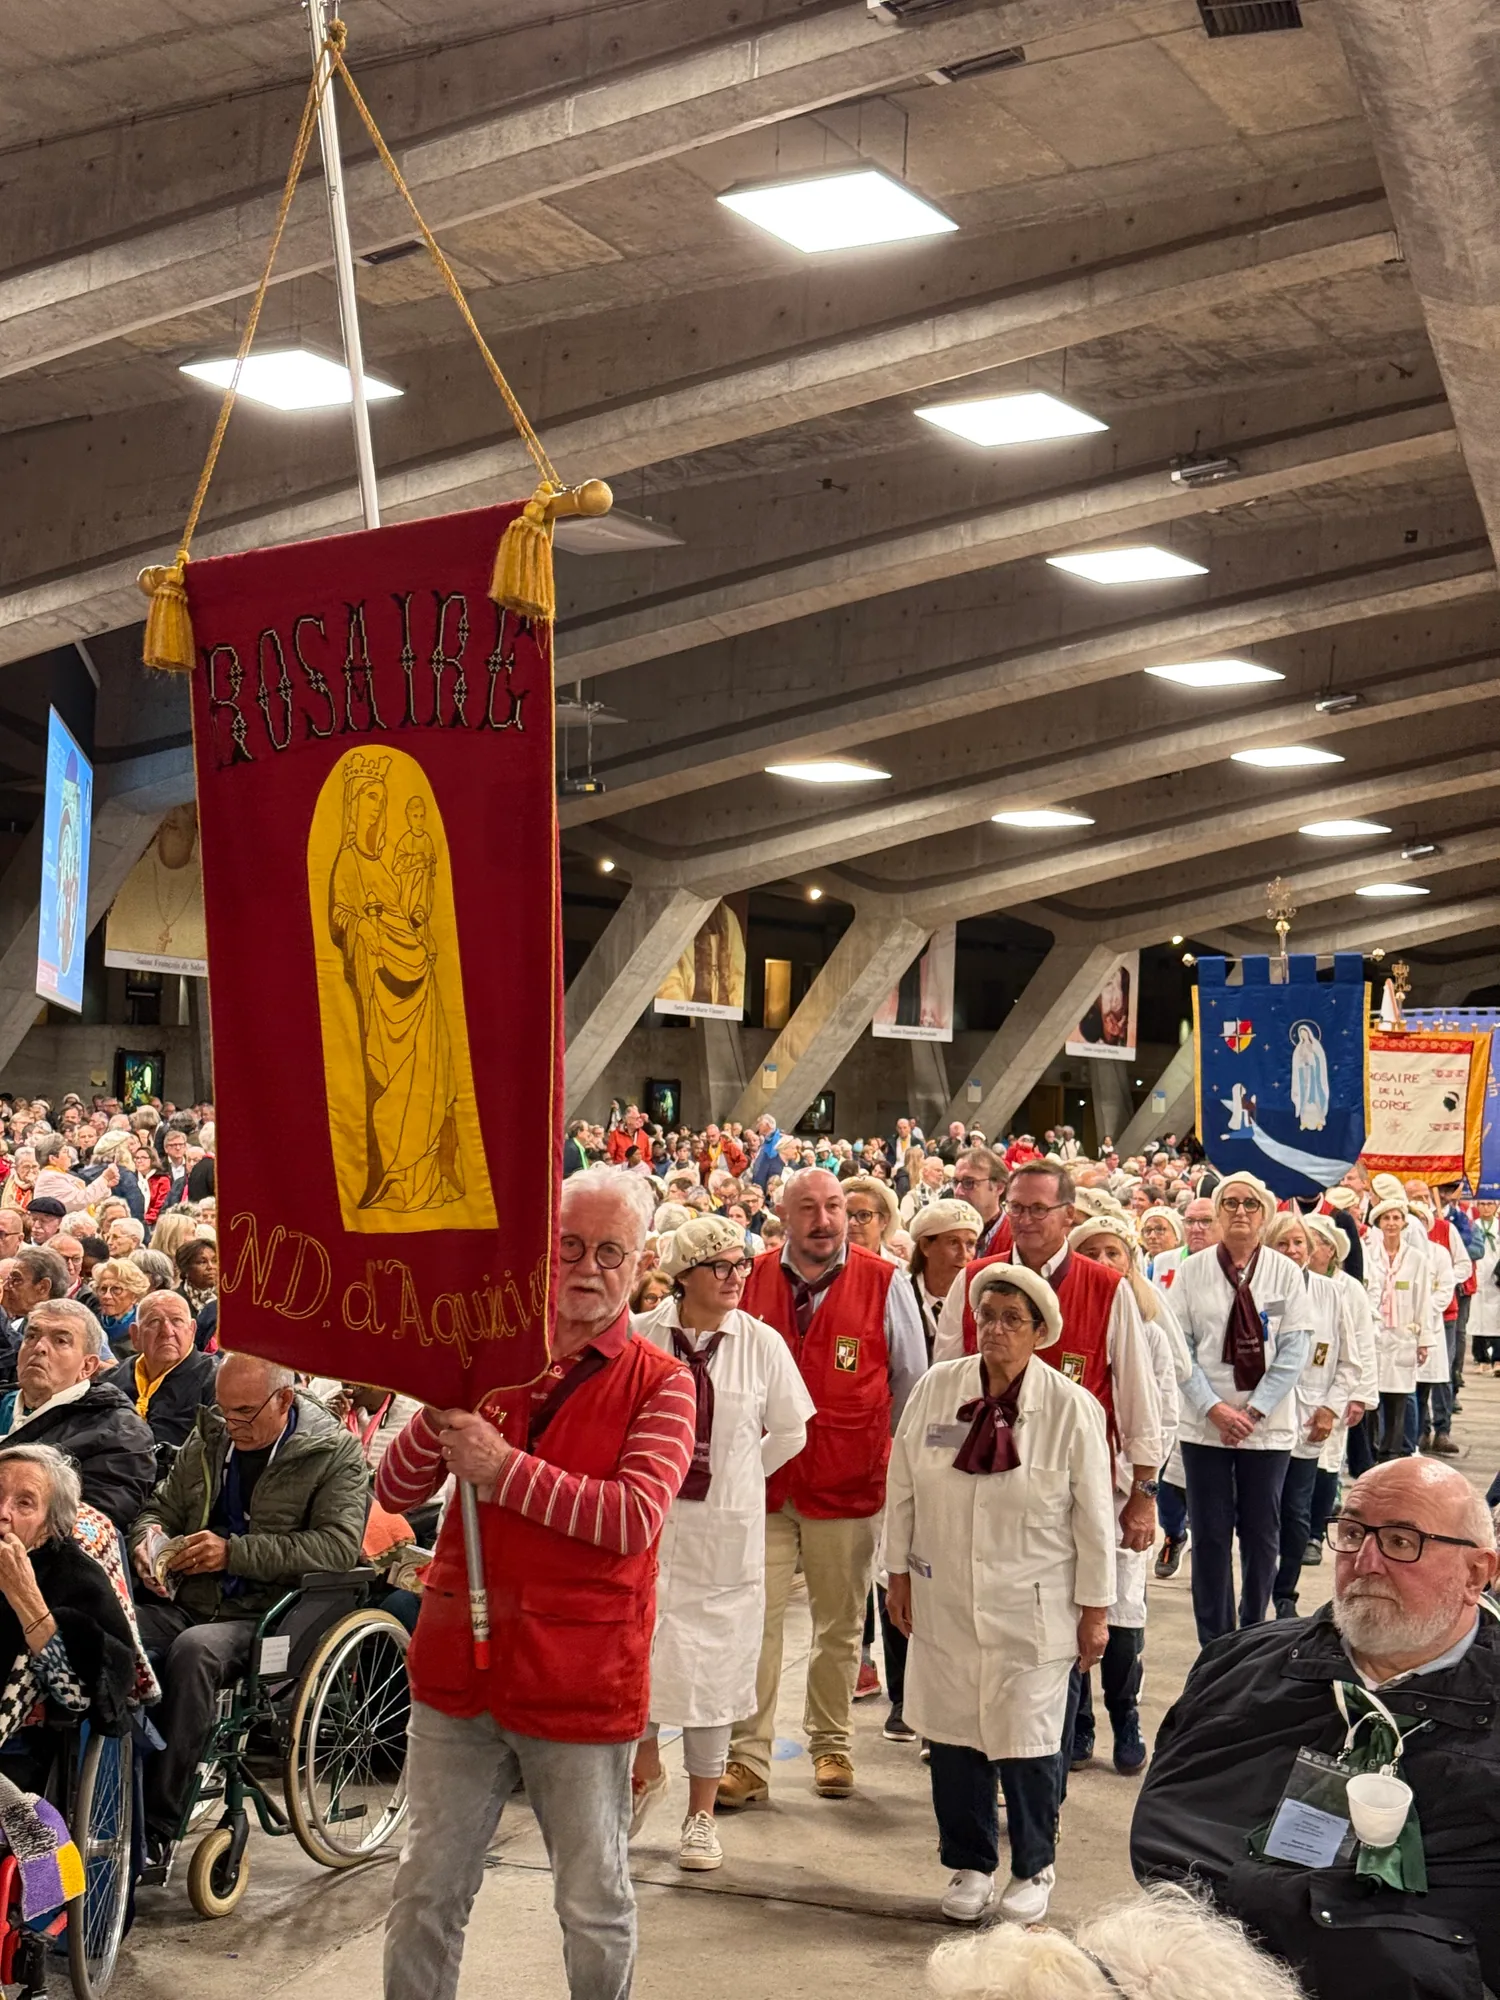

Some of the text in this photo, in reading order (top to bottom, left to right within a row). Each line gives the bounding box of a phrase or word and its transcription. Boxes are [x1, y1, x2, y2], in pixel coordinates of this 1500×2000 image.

[200, 590, 535, 770] ROSAIRE
[1378, 1086, 1404, 1097] DE LA
[1371, 1099, 1413, 1111] CORSE
